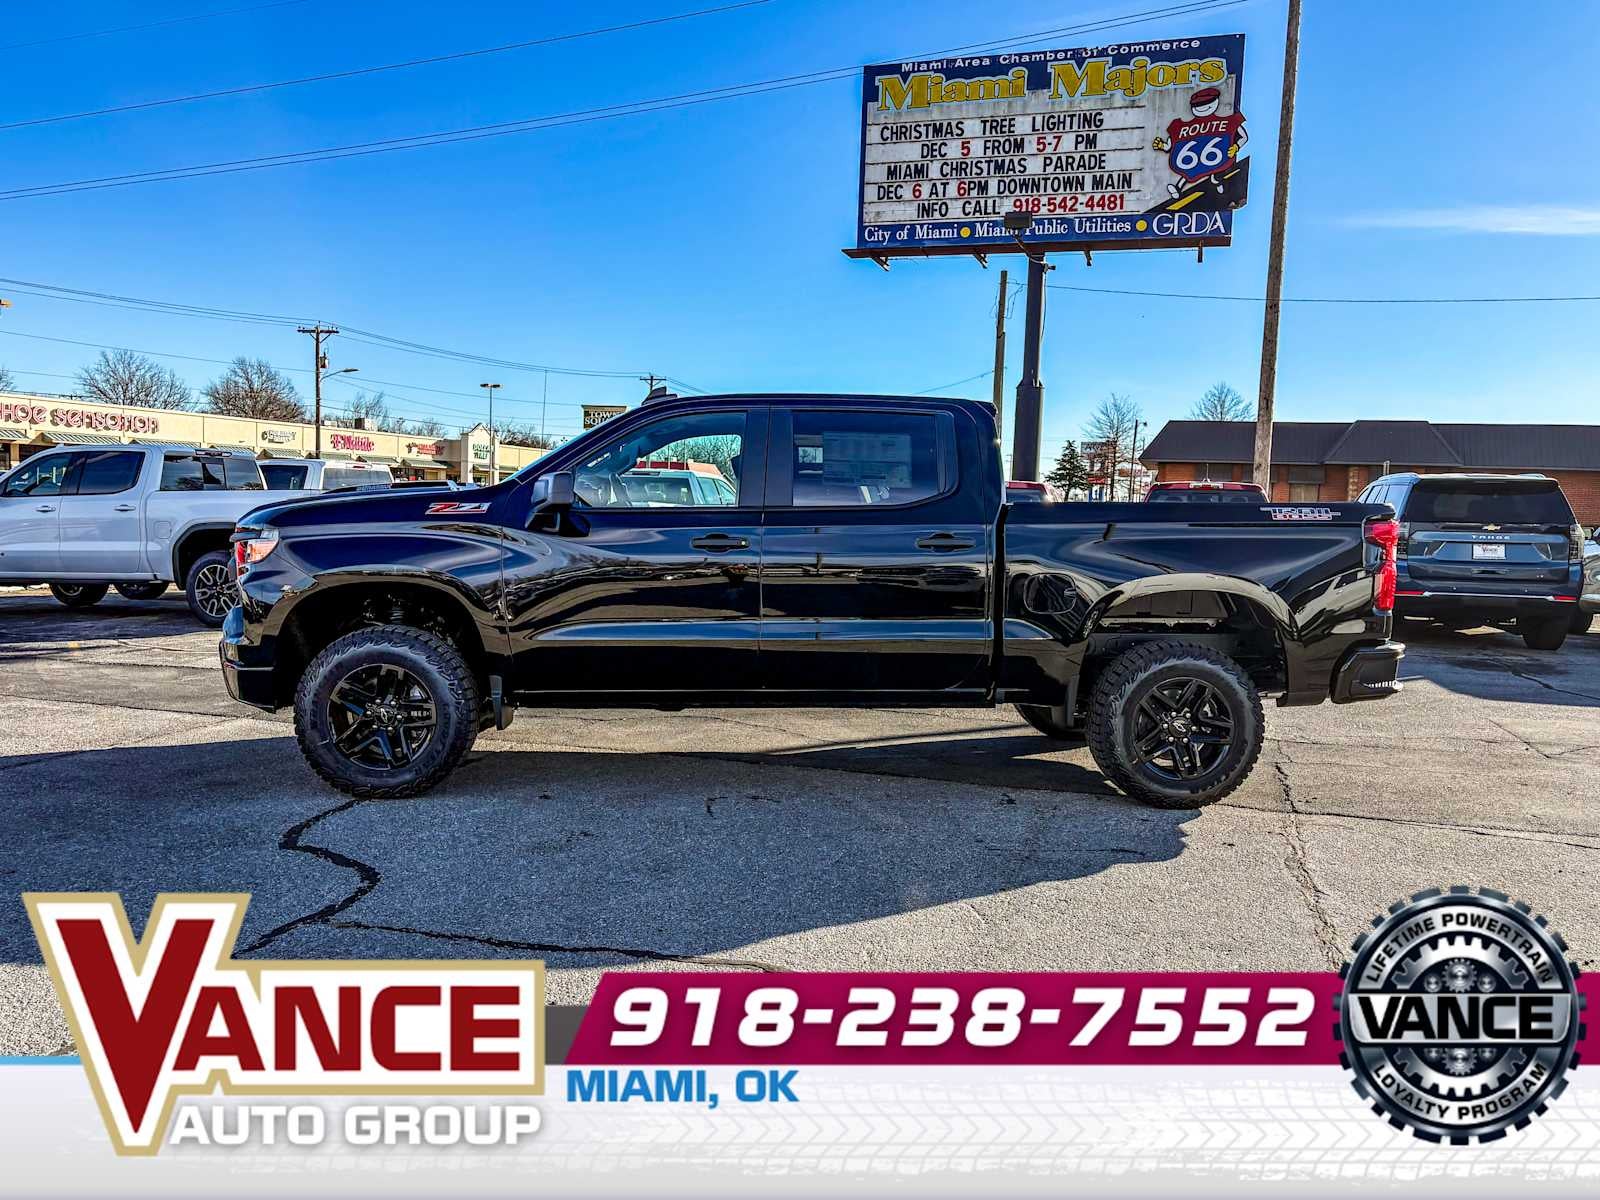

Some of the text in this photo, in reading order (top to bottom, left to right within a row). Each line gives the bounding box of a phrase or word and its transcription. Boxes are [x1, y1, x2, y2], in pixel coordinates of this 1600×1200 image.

[901, 60, 947, 73] Miami
[955, 57, 991, 68] Area
[999, 50, 1073, 65] Chamber
[1107, 39, 1201, 55] Commerce
[877, 58, 1225, 111] Miami Majors
[880, 112, 1104, 141] CHRISTMAS TREE LIGHTING
[1178, 120, 1229, 138] ROUTE
[920, 133, 1098, 158] DEC 5 FROM 5-7 PM
[1176, 136, 1223, 169] 66
[886, 153, 1106, 180] MIAMI CHRISTMAS PARADE
[877, 172, 1133, 200] DEC 6 AT 6PM DOWNTOWN MAIN
[917, 193, 1125, 218] INFO CALL 918-542-4481
[864, 226, 891, 246] City
[896, 225, 911, 240] of
[915, 224, 958, 240] Miami
[1024, 218, 1068, 236] Public
[1074, 217, 1131, 234] Utilities
[1152, 211, 1226, 236] GRDA
